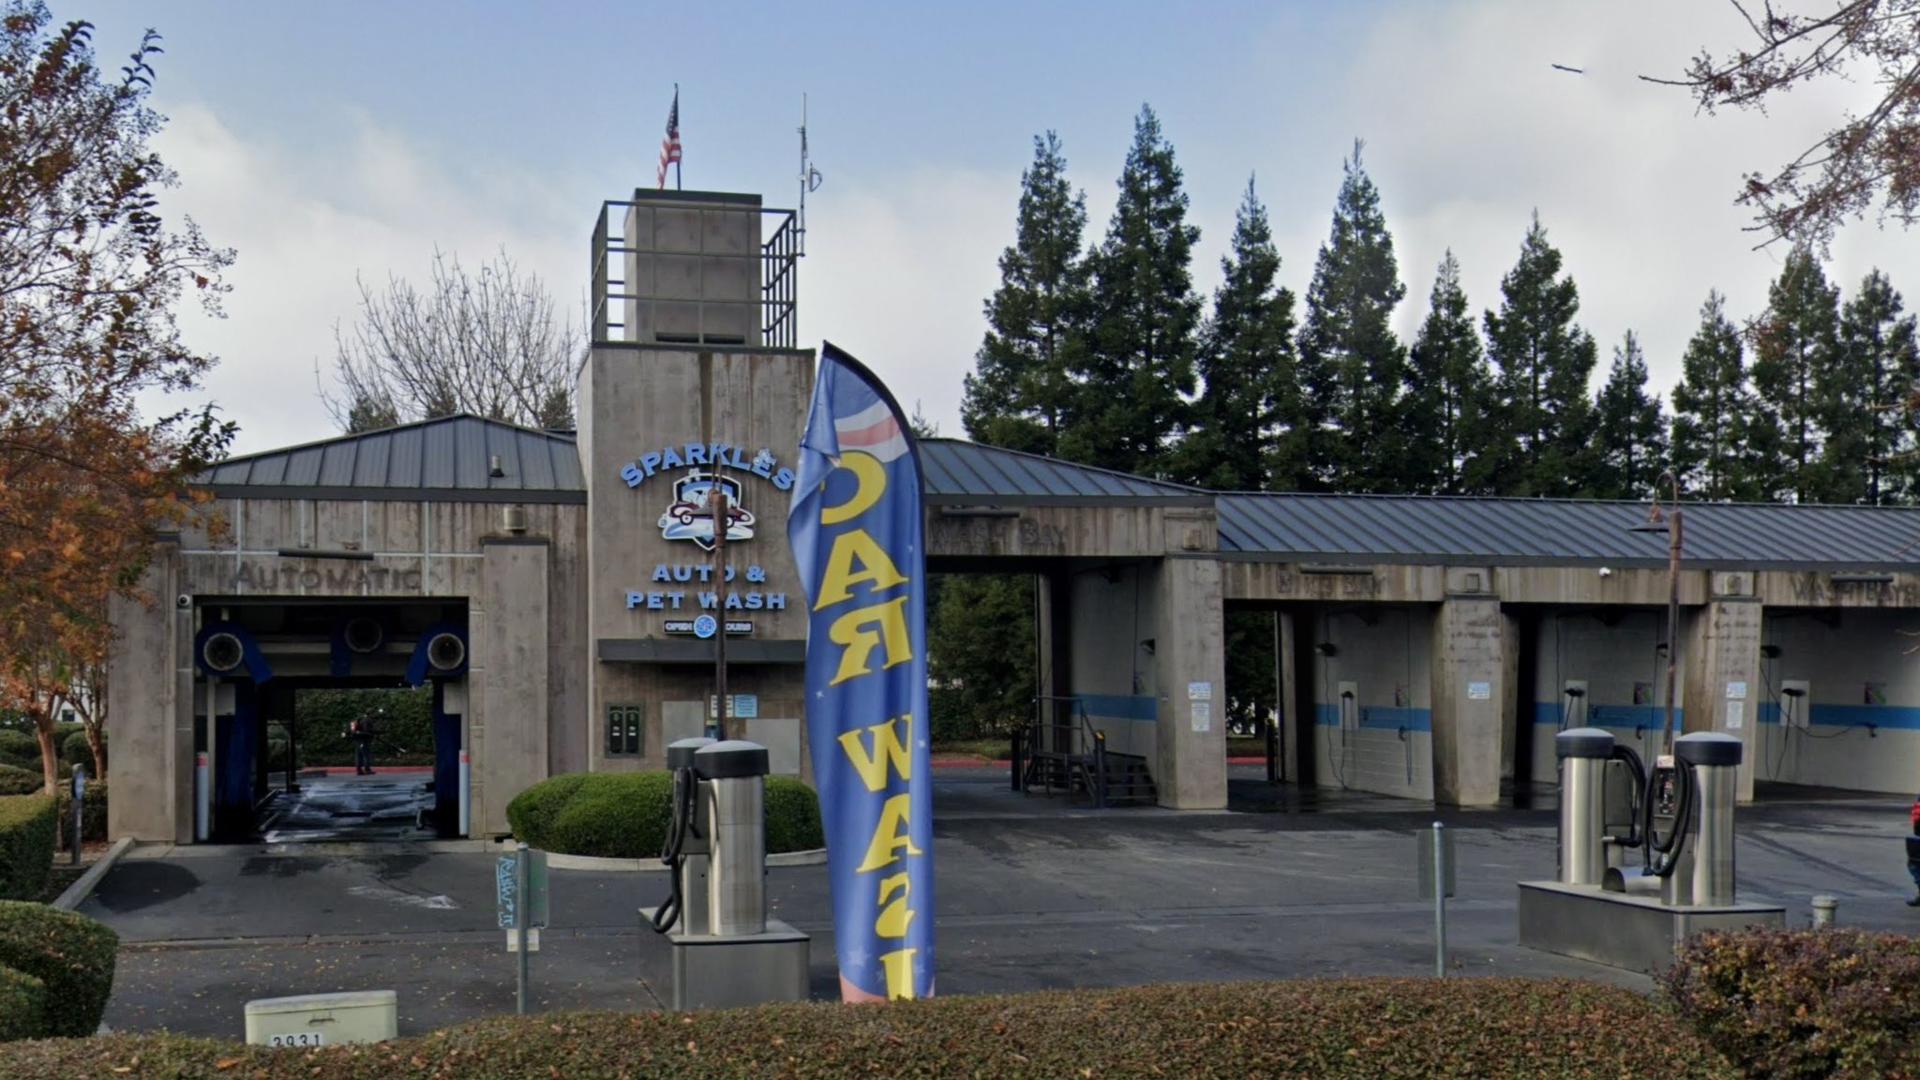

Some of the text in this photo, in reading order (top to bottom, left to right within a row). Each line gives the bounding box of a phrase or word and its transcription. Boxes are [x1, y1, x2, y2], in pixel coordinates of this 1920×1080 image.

[620, 442, 796, 490] SPARKLES
[230, 560, 422, 591] AUTOMATIC
[746, 565, 766, 583] &
[626, 591, 785, 610] PET WASH
